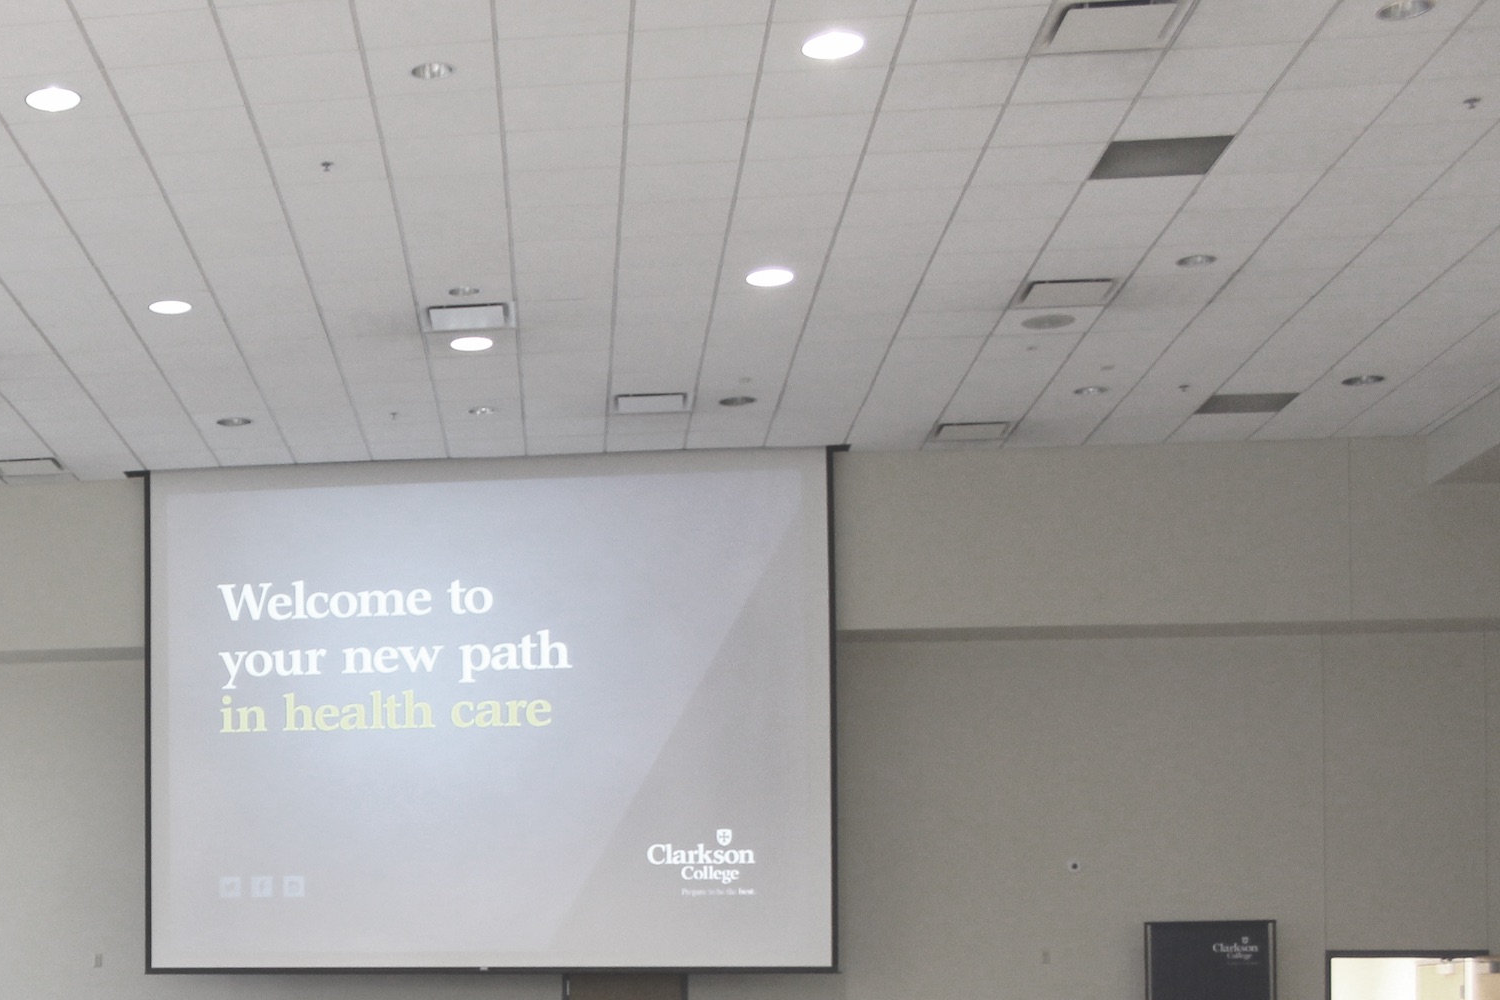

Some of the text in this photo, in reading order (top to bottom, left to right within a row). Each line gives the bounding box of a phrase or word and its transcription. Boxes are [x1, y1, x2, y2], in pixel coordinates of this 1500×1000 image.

[218, 579, 493, 622] Welcome to
[219, 629, 572, 689] your new path
[219, 690, 553, 734] in health care
[646, 843, 756, 865] Clarkson
[681, 865, 740, 884] College
[1212, 942, 1259, 953] Clarkson
